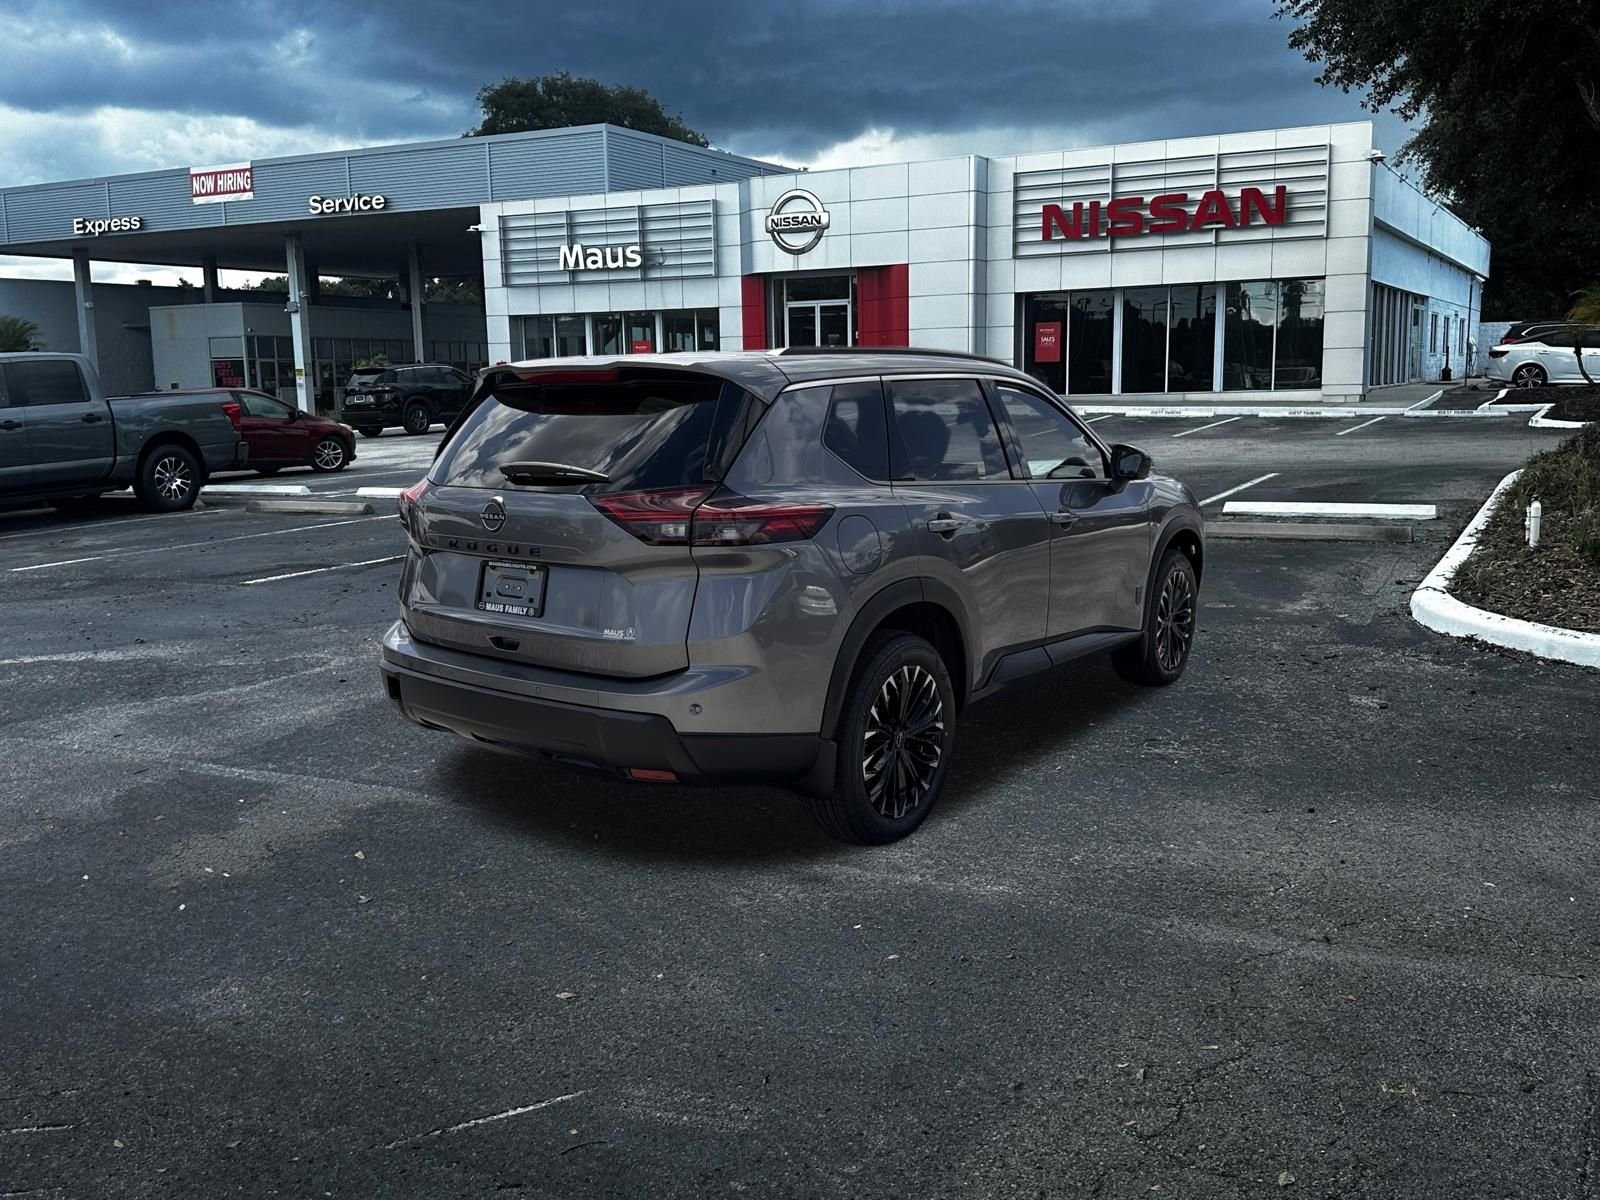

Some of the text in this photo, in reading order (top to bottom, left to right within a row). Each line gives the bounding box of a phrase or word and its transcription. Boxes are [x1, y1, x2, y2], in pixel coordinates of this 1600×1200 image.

[192, 171, 251, 195] NOW HIRING
[308, 194, 385, 214] Service
[1042, 185, 1287, 241] NISSAN
[73, 216, 141, 236] Express
[771, 215, 822, 228] NISSAN
[559, 244, 642, 271] Maus
[448, 539, 541, 556] ROGUE
[485, 602, 528, 615] MAUS FAMILY
[603, 628, 624, 637] MAUS
